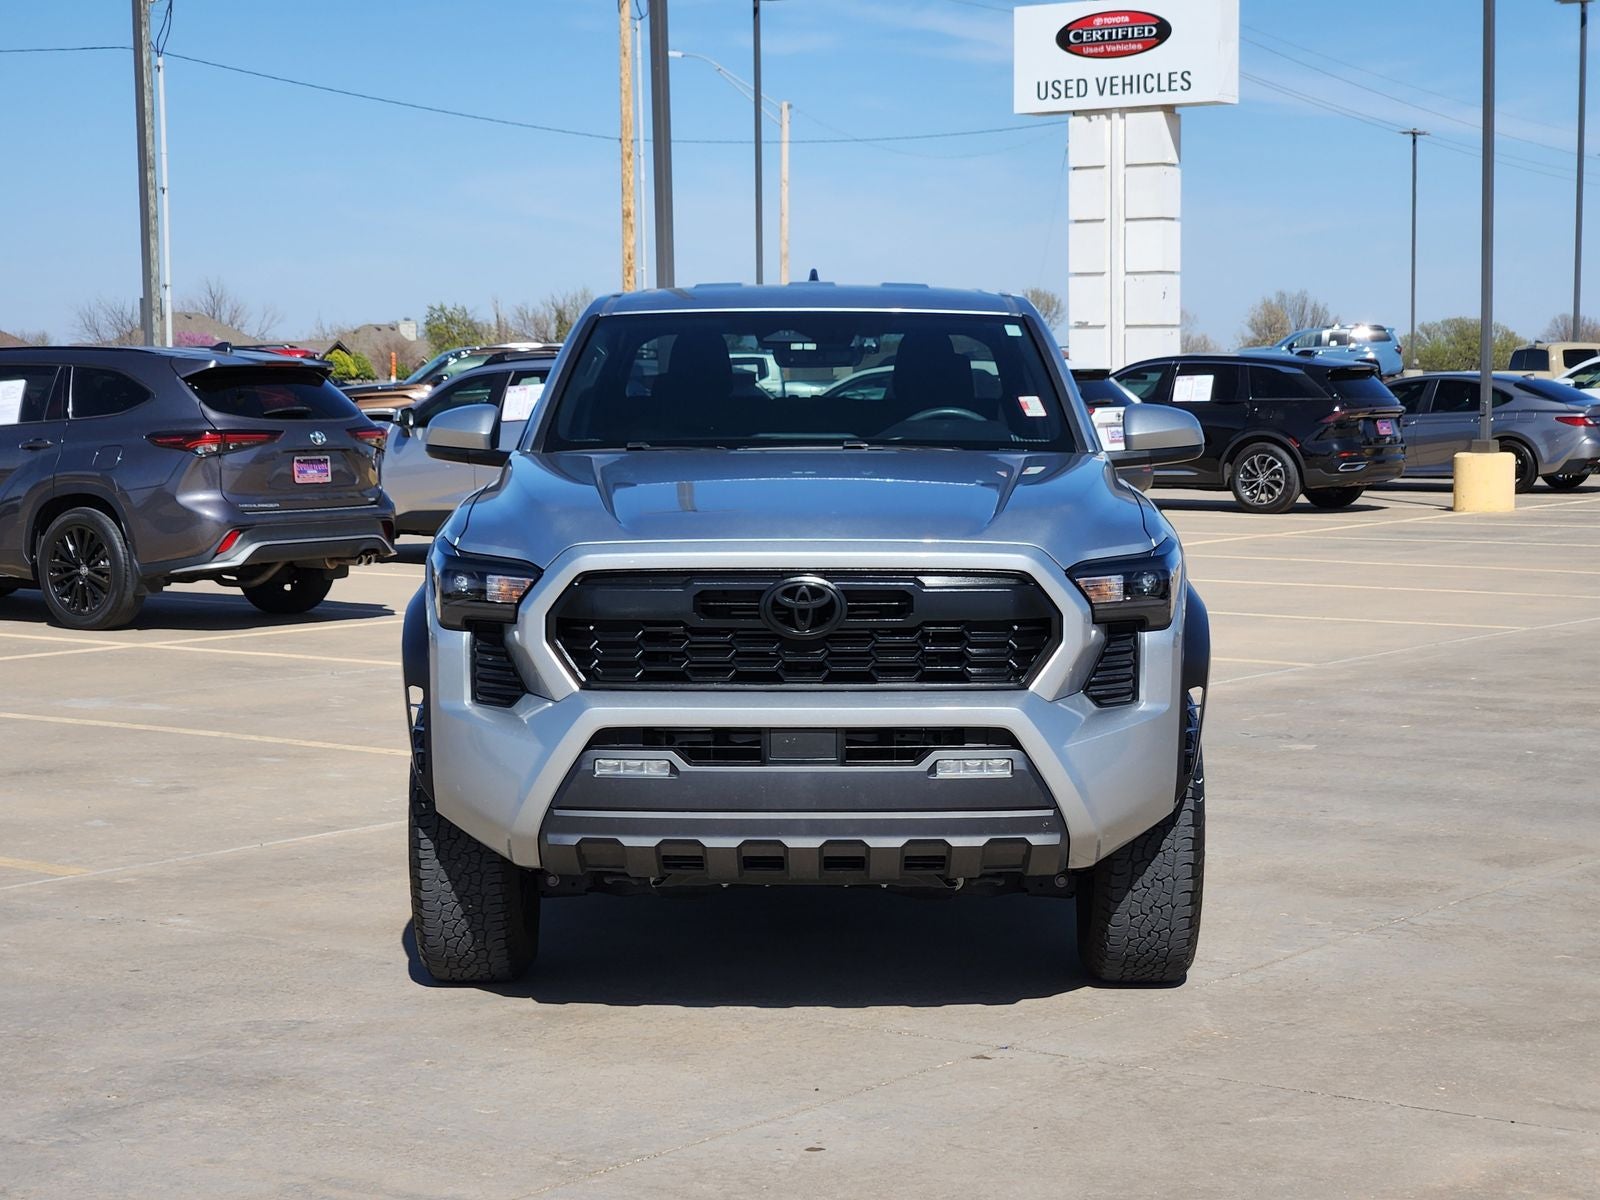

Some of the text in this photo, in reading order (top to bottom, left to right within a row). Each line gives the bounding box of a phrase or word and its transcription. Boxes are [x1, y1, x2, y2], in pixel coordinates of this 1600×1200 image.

[1103, 16, 1130, 24] TOYOTA
[1068, 25, 1157, 43] CERTIFIED
[1082, 43, 1143, 54] Used Vehicles
[1037, 70, 1192, 101] USED VEHICLES
